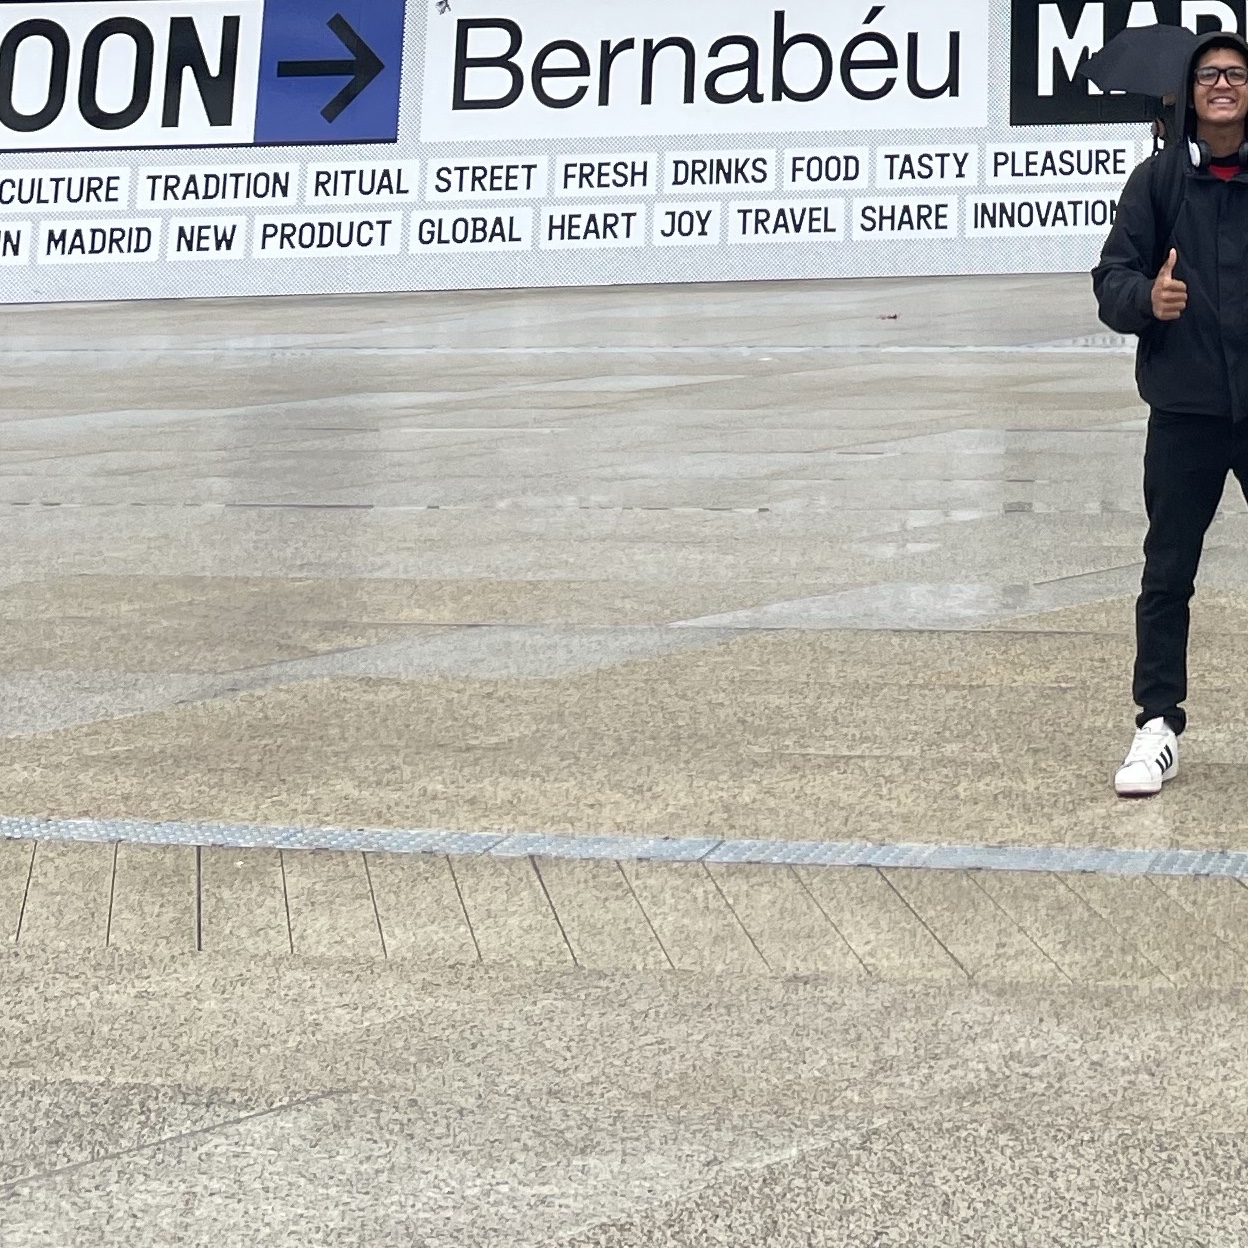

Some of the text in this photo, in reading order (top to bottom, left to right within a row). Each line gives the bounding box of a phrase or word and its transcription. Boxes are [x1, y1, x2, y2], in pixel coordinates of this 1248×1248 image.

[452, 5, 961, 110] Bernabéu
[0, 176, 120, 205] CULTURE
[147, 171, 290, 201] TRADITION
[315, 168, 409, 197] RITUAL
[435, 164, 538, 193] STREET
[563, 160, 648, 189] FRESH
[672, 157, 768, 186] DRINKS
[791, 155, 860, 182] FOOD
[885, 152, 969, 180] TASTY
[993, 149, 1126, 177] PLEASURE
[46, 227, 152, 256] MADRID
[177, 224, 237, 252] NEW
[262, 220, 392, 249] PRODUCT
[418, 216, 522, 245] GLOBAL
[548, 212, 637, 241] HEART
[660, 210, 712, 237] JOY
[738, 207, 837, 234] TRAVEL
[860, 203, 948, 231] SHARE
